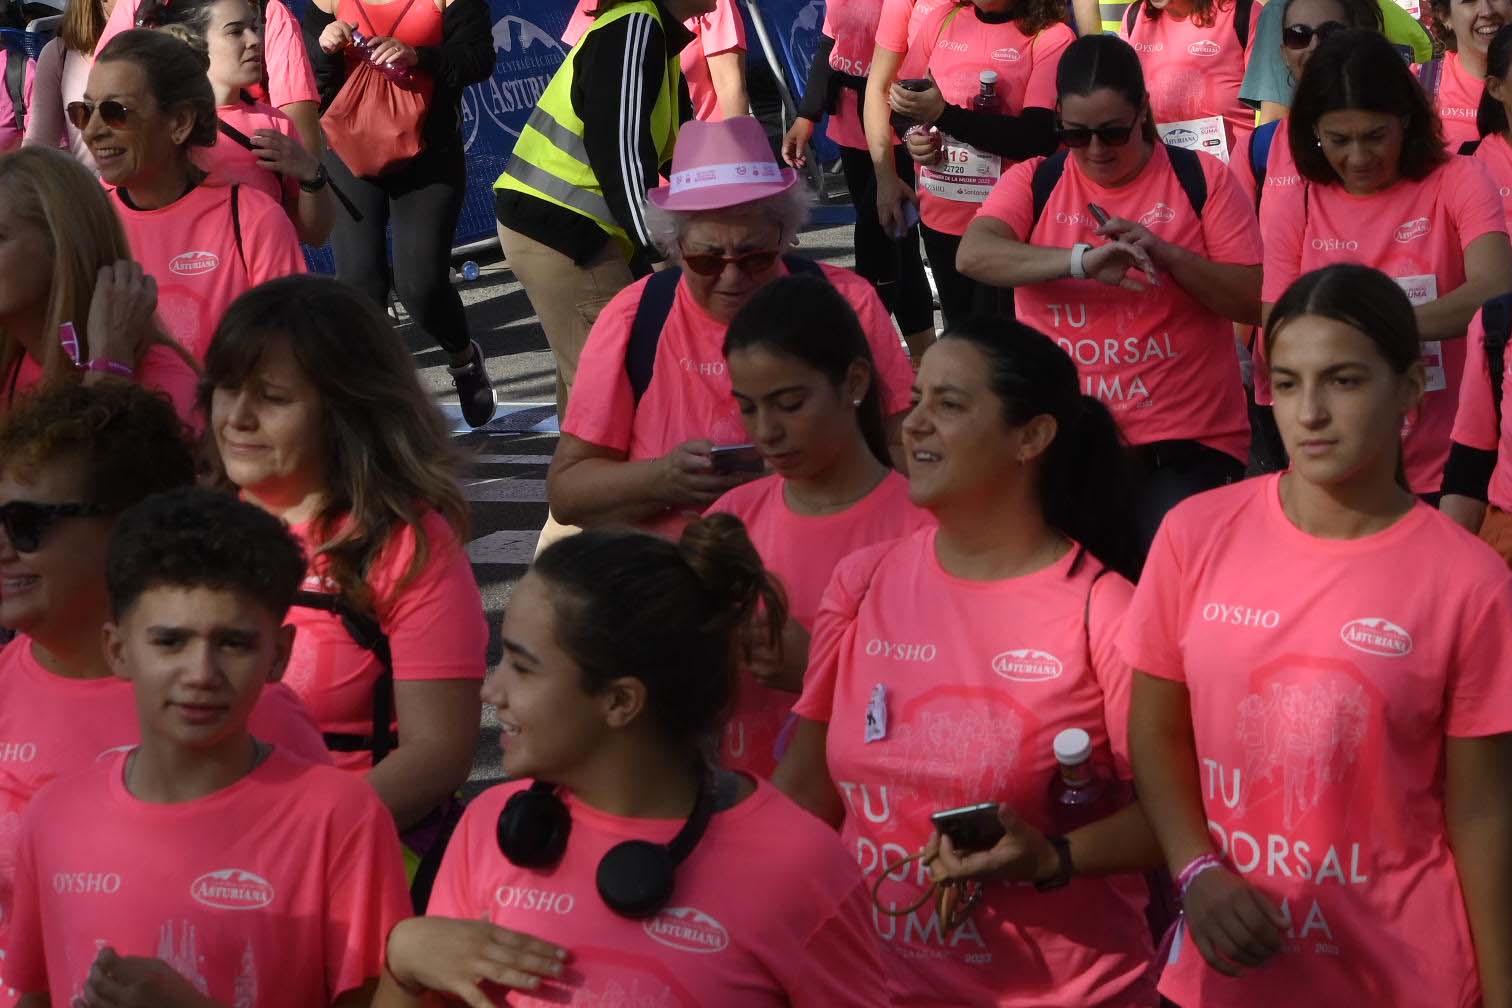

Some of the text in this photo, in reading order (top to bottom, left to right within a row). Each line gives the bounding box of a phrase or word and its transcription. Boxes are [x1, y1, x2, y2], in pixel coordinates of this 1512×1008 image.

[943, 165, 965, 174] 22720
[1312, 238, 1358, 252] OYSHO
[1047, 304, 1087, 328] TU
[1057, 333, 1177, 365] DORSAL
[1202, 602, 1281, 629] OYSHO
[865, 639, 937, 663] OYSHO
[1346, 624, 1408, 652] ASTURIANA
[996, 657, 1058, 677] ASTURIANA
[1202, 759, 1242, 809] TU
[838, 780, 891, 823] TU
[857, 837, 937, 887] DOR
[1206, 822, 1369, 886] DORSAL
[53, 872, 121, 895] OYSHO
[200, 881, 267, 903] ASTURIANA
[495, 885, 575, 915] OYSHO
[650, 918, 721, 947] ASTURIANA
[872, 900, 987, 948] UMA
